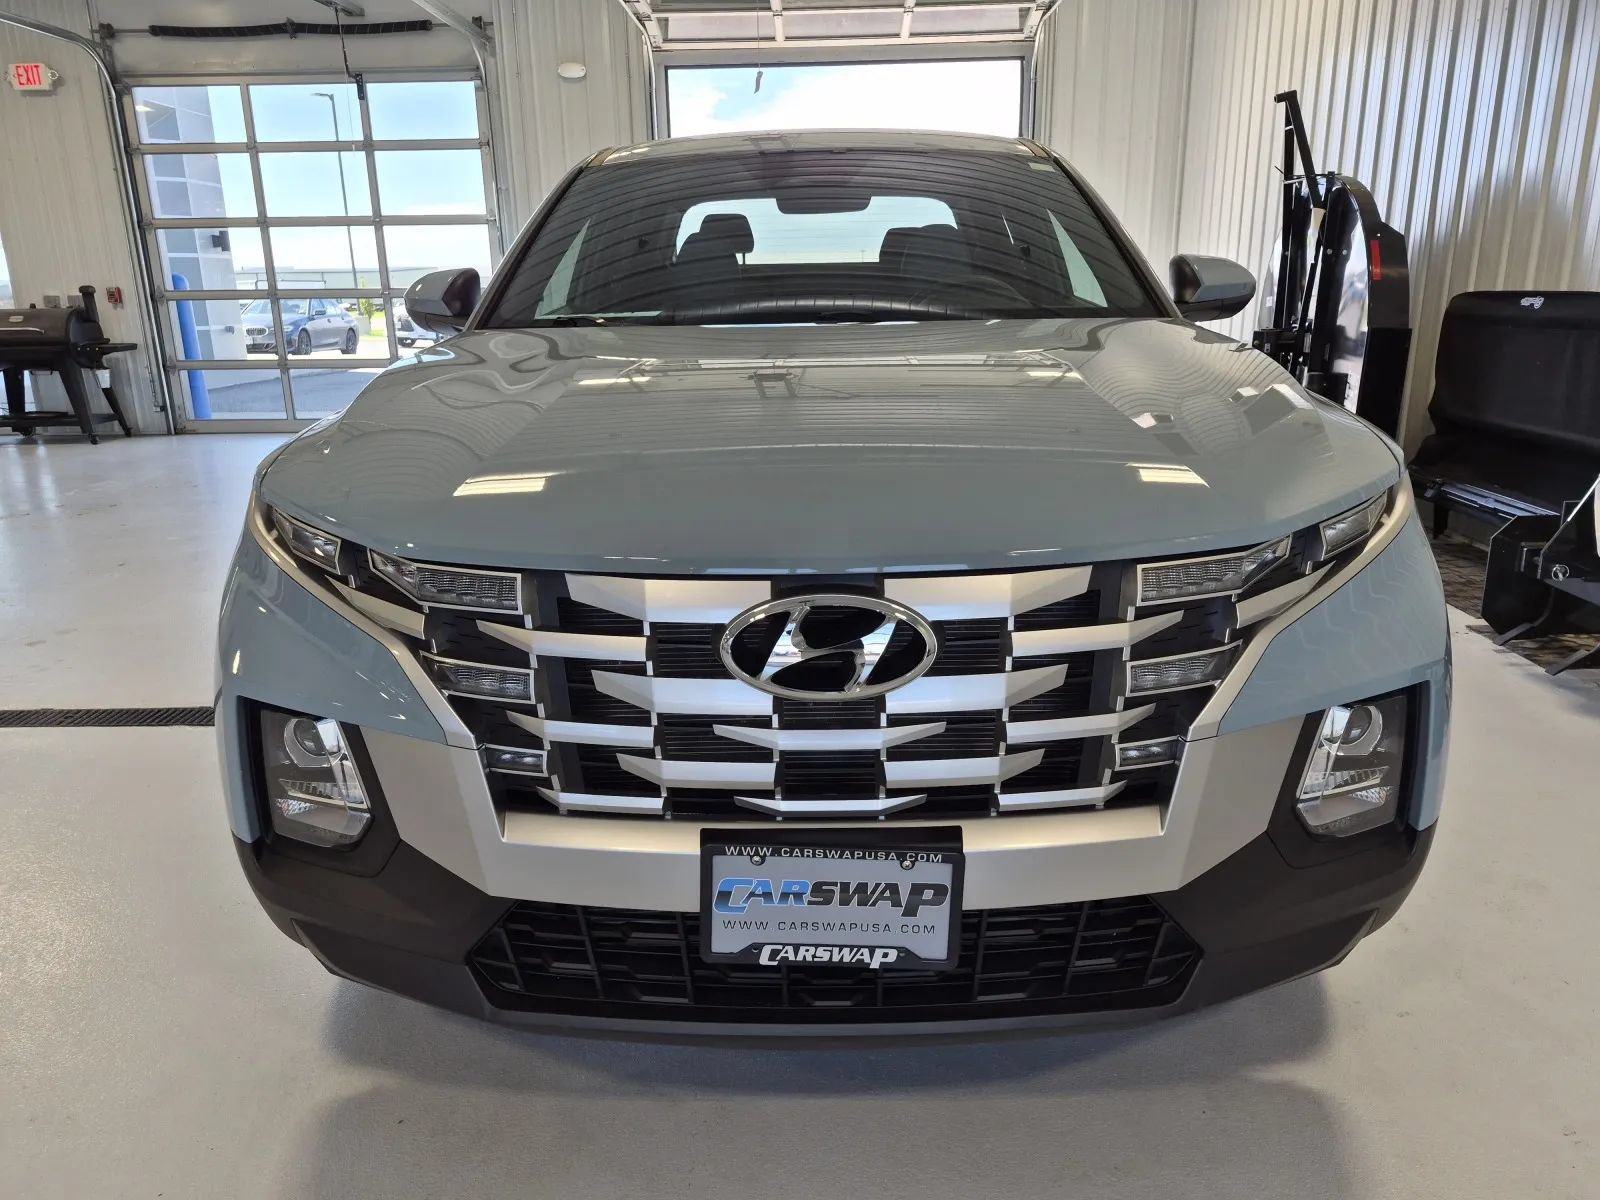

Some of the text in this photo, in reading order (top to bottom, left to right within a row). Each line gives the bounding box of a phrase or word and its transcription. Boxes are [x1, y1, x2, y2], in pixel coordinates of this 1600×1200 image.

[16, 65, 41, 85] EXIT
[725, 846, 943, 863] WWW.CARSWAPUSA.COM
[713, 877, 949, 917] CARSWAP
[722, 919, 936, 935] WWW.CARSWAPUSA.COM
[758, 944, 898, 969] CARSWAP
